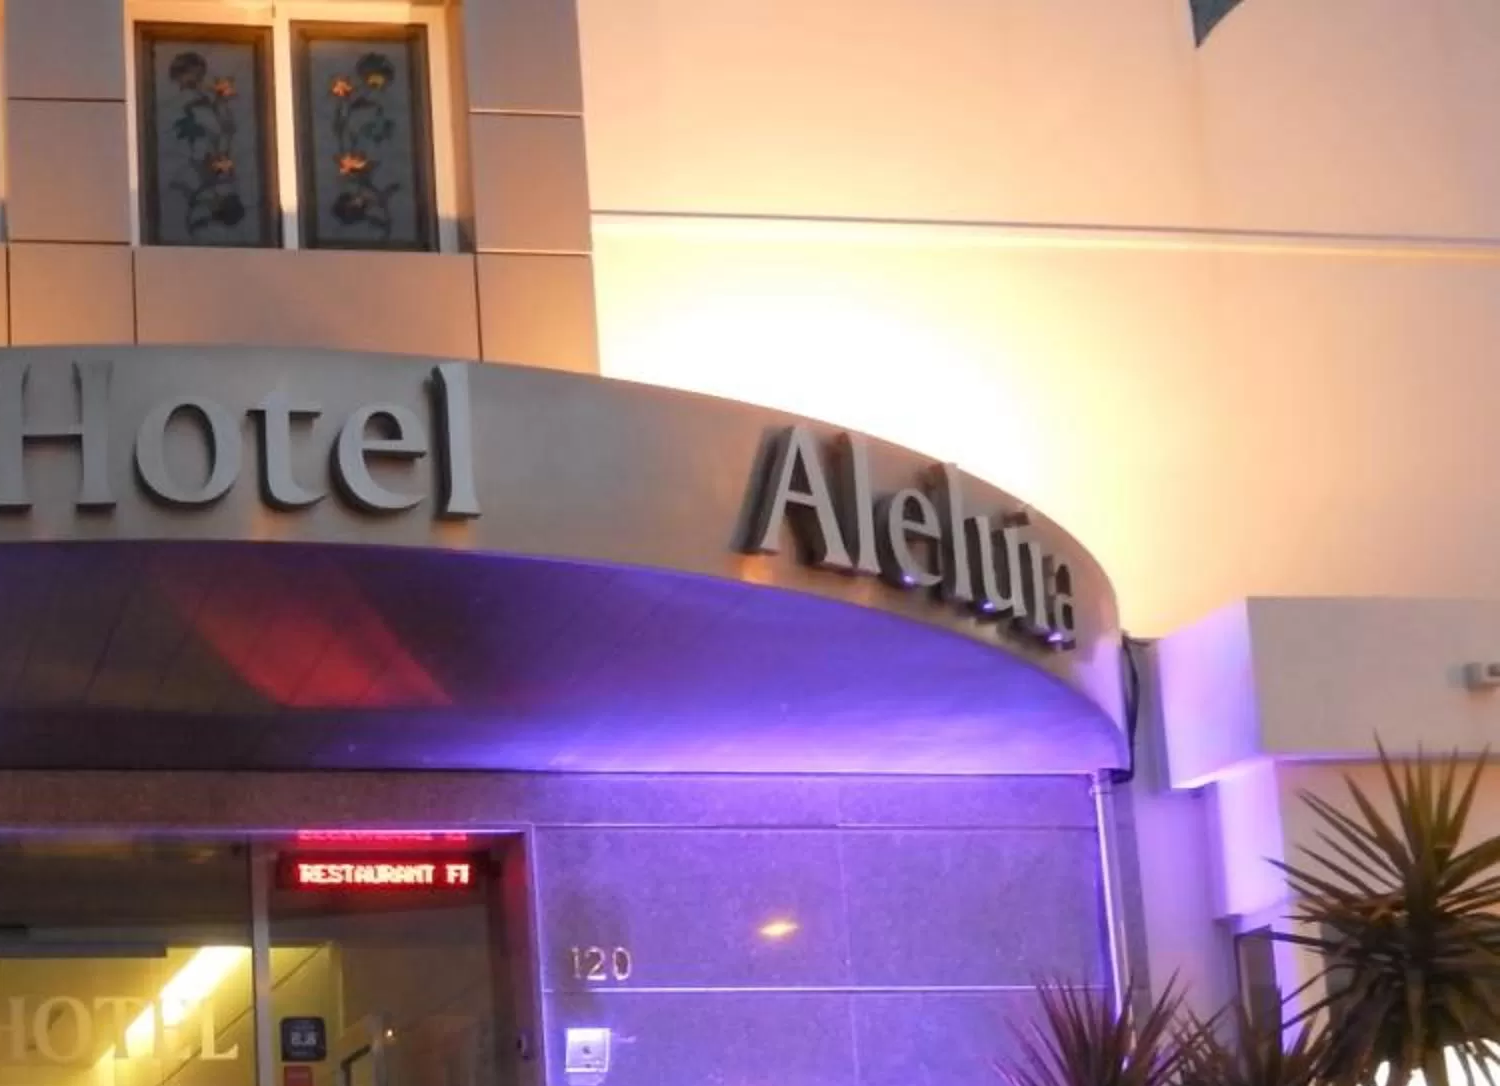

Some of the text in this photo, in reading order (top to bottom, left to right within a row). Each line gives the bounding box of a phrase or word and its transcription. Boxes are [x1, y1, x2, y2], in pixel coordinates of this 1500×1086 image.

[735, 424, 1078, 648] Aleluia
[297, 863, 435, 884] RESTAURANT
[571, 946, 632, 981] 120
